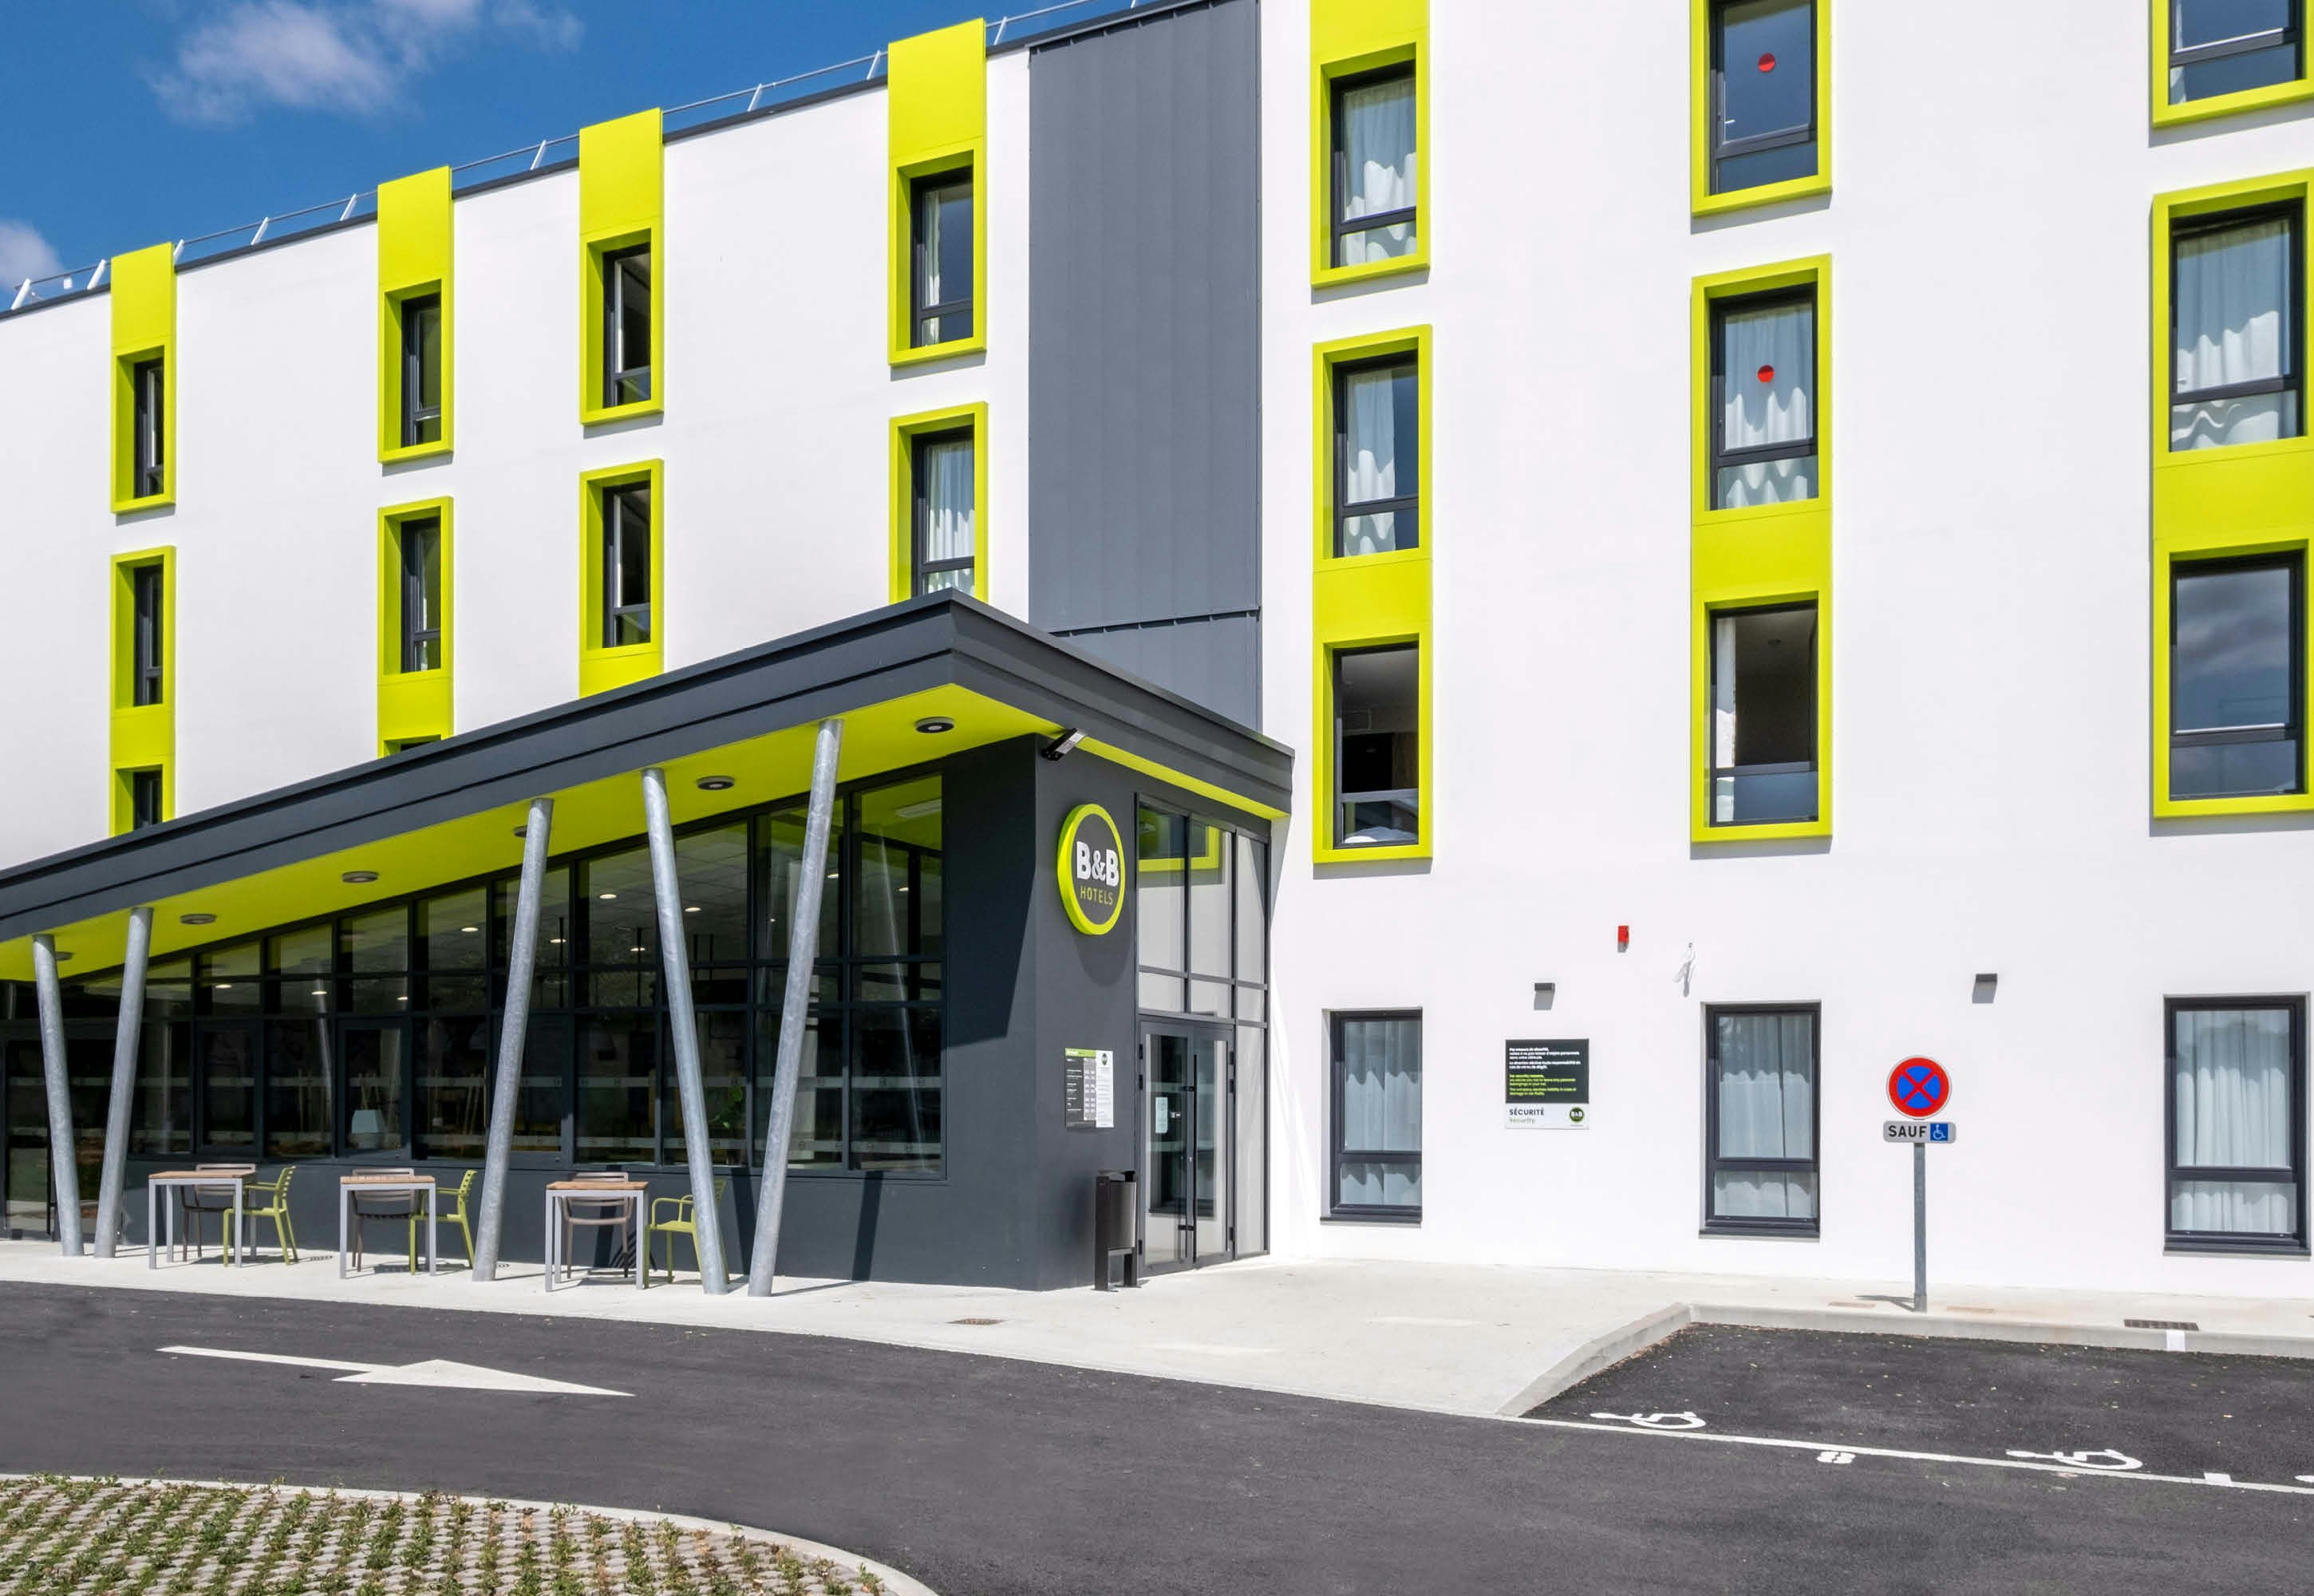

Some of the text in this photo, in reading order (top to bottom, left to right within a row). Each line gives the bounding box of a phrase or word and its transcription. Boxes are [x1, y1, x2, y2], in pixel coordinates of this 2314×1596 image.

[1076, 841, 1119, 887] B&B
[1080, 886, 1113, 906] HOTELS
[1509, 1107, 1545, 1116] SÉCURITÉ
[1888, 1125, 1927, 1138] SAUF
